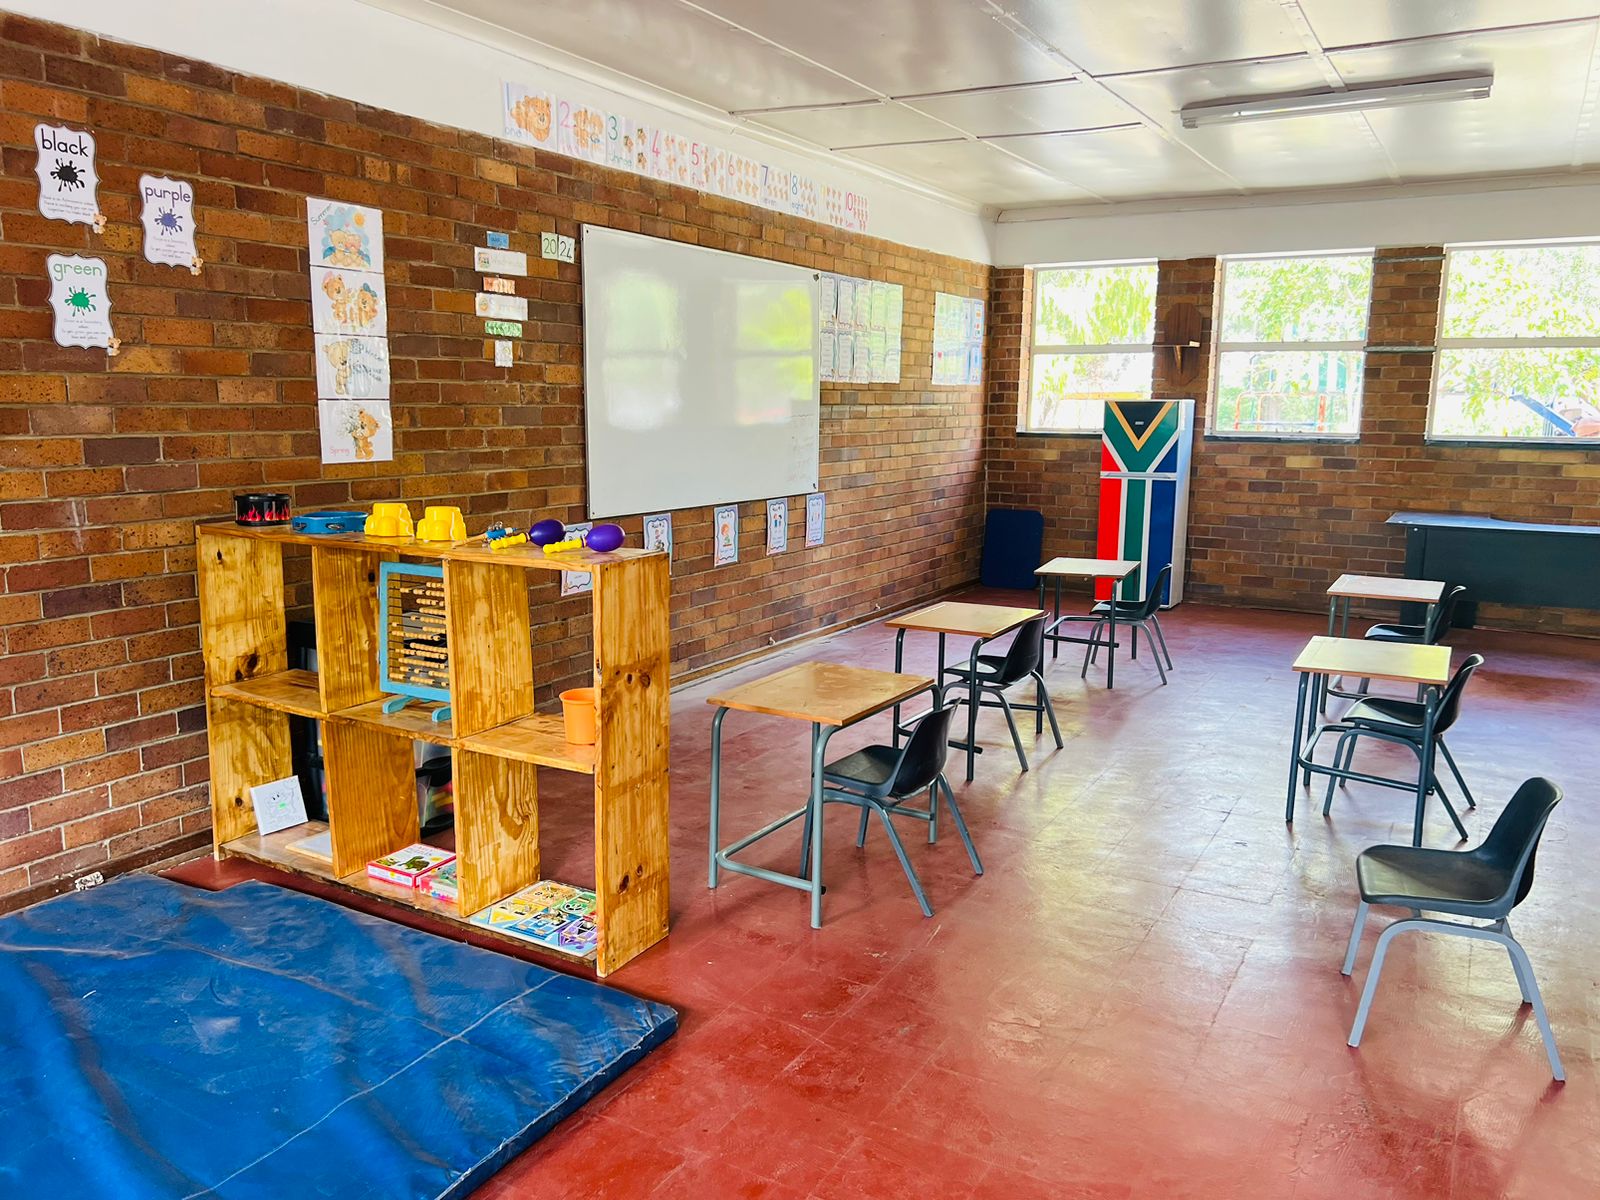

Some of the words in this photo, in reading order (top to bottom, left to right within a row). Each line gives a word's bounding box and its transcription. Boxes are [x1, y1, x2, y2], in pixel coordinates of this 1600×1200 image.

[559, 100, 577, 129] 2
[608, 116, 619, 141] 3
[41, 128, 89, 157] black
[652, 130, 662, 158] 4
[691, 142, 700, 166] 5
[728, 154, 736, 177] 6
[761, 164, 769, 186] 7
[145, 184, 191, 208] purple
[792, 175, 798, 196] 8
[845, 191, 854, 212] 10
[543, 237, 557, 255] 20
[53, 262, 103, 282] green
